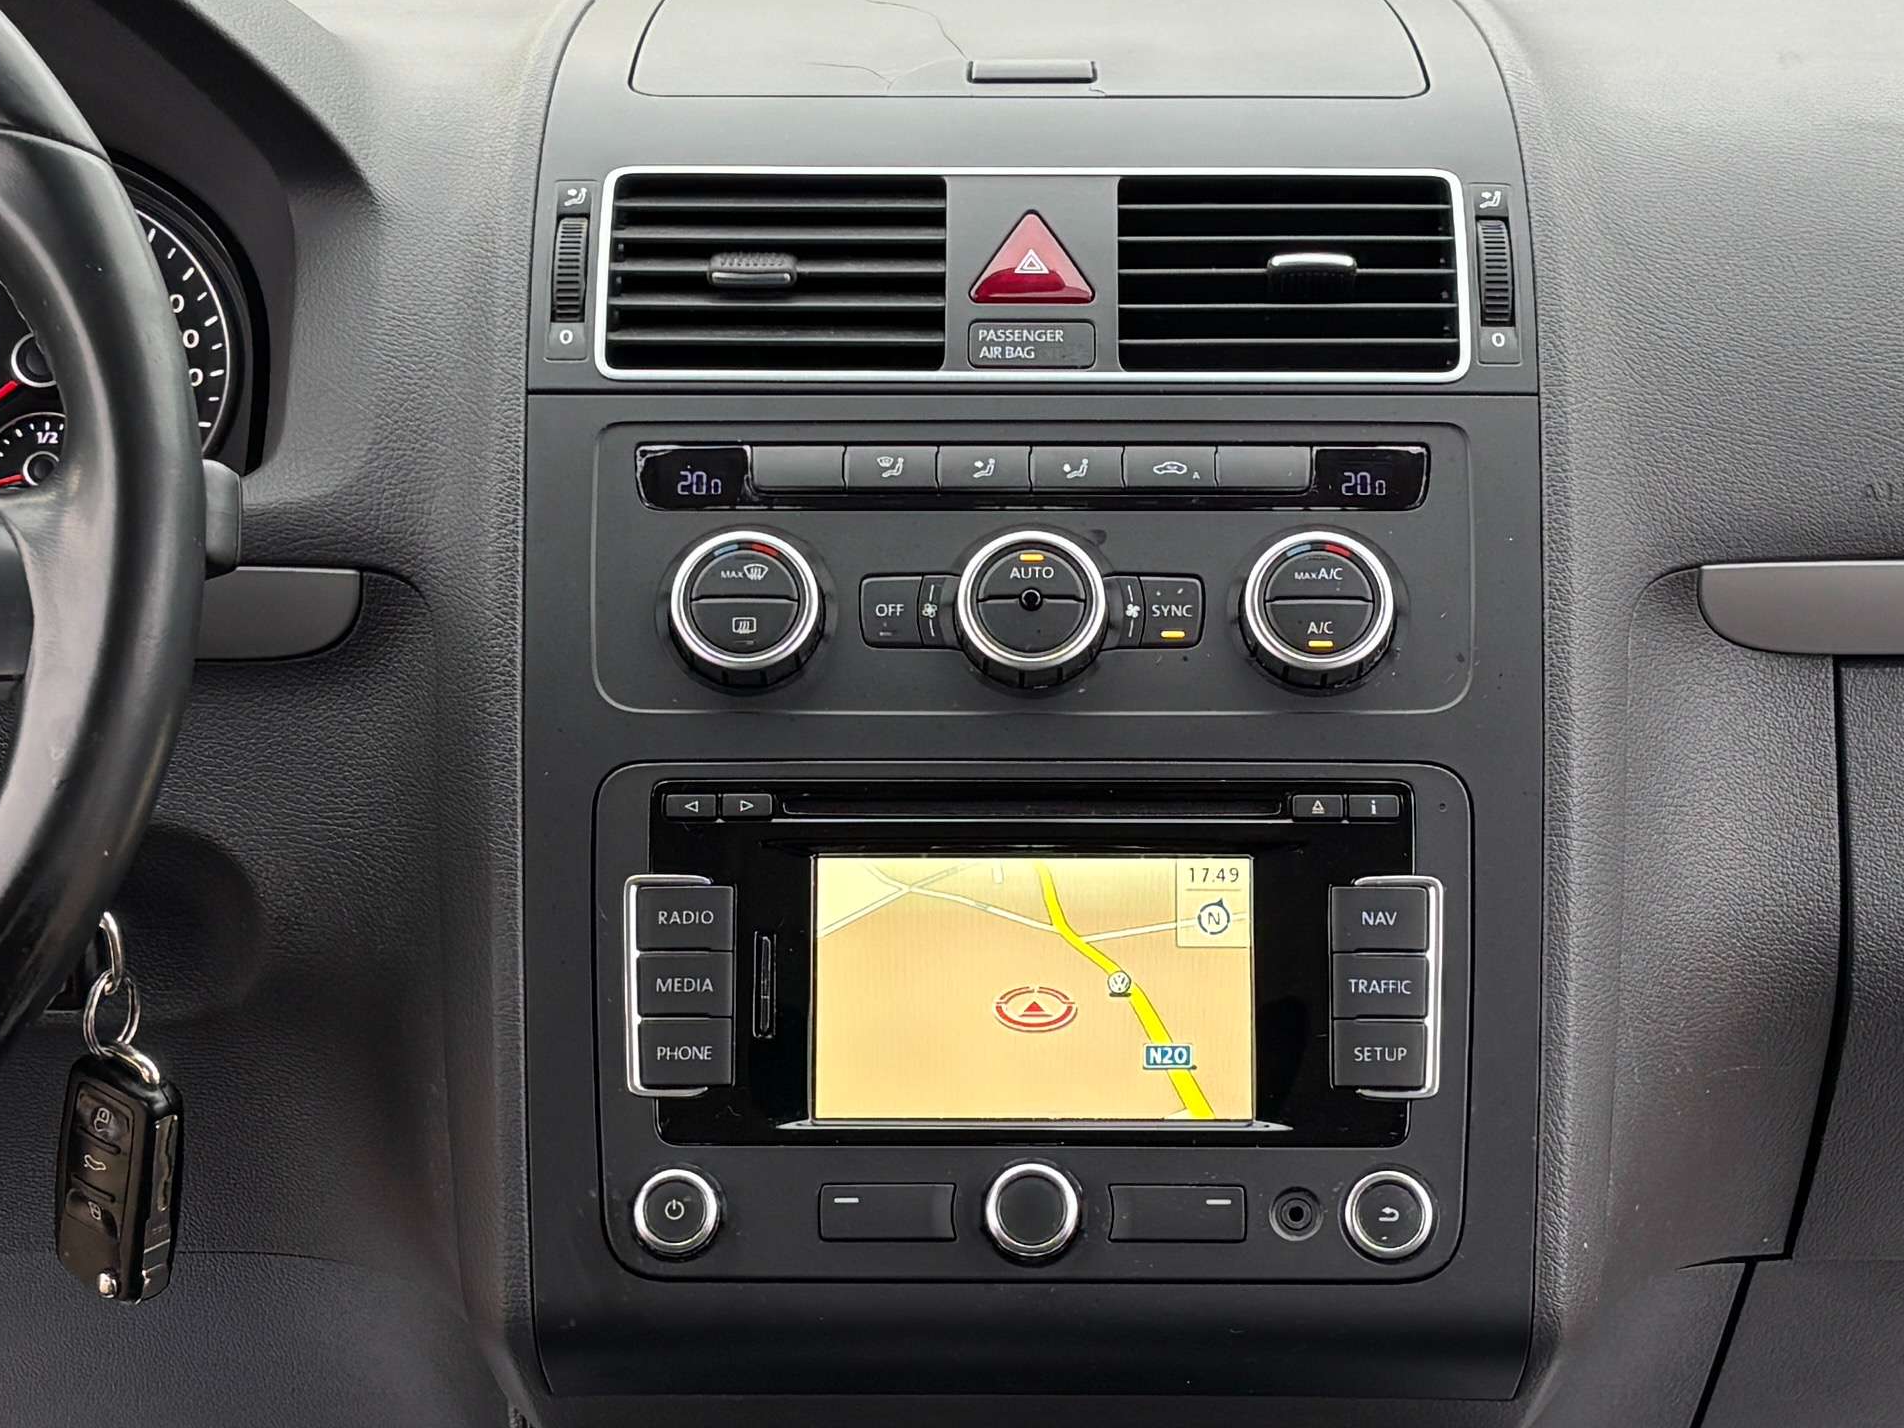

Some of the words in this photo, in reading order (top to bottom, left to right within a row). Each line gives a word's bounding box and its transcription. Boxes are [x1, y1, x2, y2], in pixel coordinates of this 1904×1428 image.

[978, 329, 1064, 342] PASSENGER
[979, 346, 1002, 359] AIR
[1005, 346, 1036, 359] BAG
[36, 431, 59, 444] 1/2
[1009, 566, 1055, 580] AUTO
[1317, 567, 1344, 581] A/C
[875, 604, 905, 617] OFF
[1151, 604, 1194, 618] SYNC
[1306, 621, 1334, 635] A/C
[1188, 867, 1240, 884] 17.49
[657, 910, 715, 925] RADIO
[1207, 911, 1221, 926] N
[1361, 910, 1398, 926] NAV
[655, 977, 714, 993] MEDIA
[1347, 979, 1413, 996] TRAFFIC
[656, 1045, 713, 1061] PHONE
[1149, 1047, 1187, 1064] N20
[1353, 1047, 1408, 1062] SETUP
